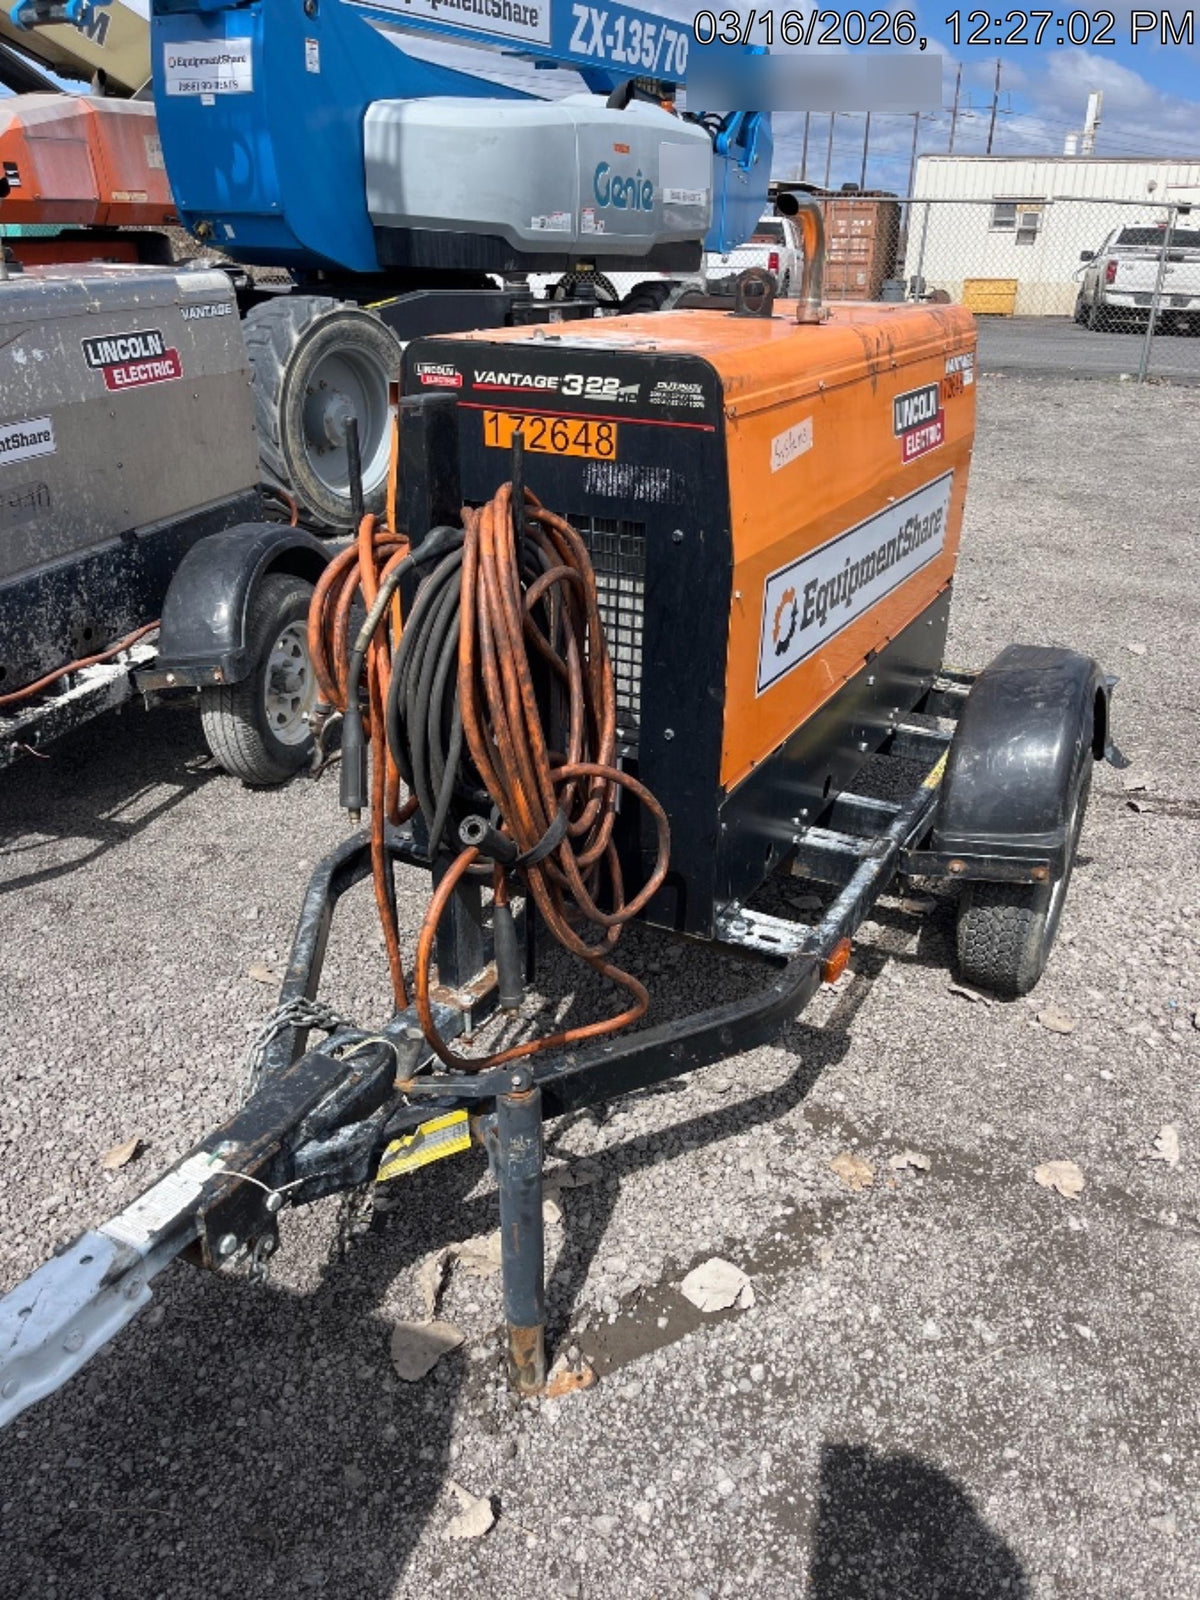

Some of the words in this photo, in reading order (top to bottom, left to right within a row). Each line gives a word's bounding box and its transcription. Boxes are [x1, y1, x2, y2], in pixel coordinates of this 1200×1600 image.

[570, 4, 688, 76] ZX-135/70
[594, 161, 654, 213] Genie
[180, 303, 232, 320] VANTAGE
[86, 333, 163, 366] LINCOLN
[112, 360, 175, 385] ELECTRIC
[416, 363, 455, 377] LINCOLN
[473, 369, 560, 390] VANTAGE
[561, 374, 621, 396] 322
[895, 390, 938, 431] LINCOLN
[487, 412, 615, 457] 172648
[906, 422, 942, 456] ELECTRIC
[800, 506, 944, 632] EquipmentShare
